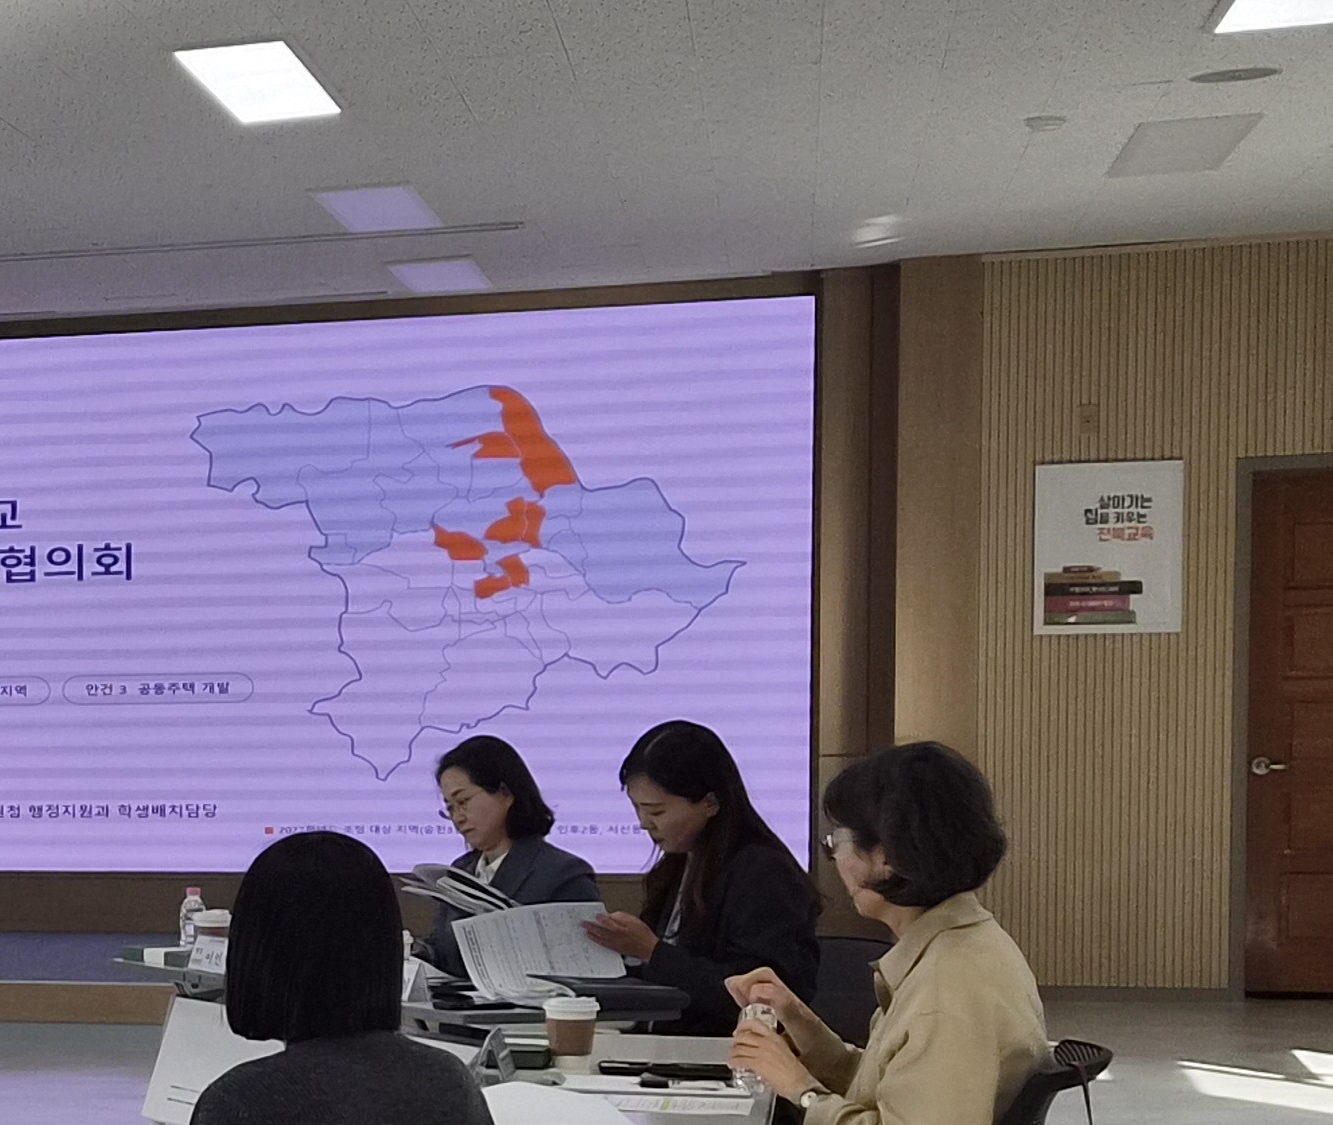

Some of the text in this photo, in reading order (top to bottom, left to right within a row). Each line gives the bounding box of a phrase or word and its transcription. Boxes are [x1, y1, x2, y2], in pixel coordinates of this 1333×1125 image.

[85, 681, 231, 697] 안건 3 공동주택 개발
